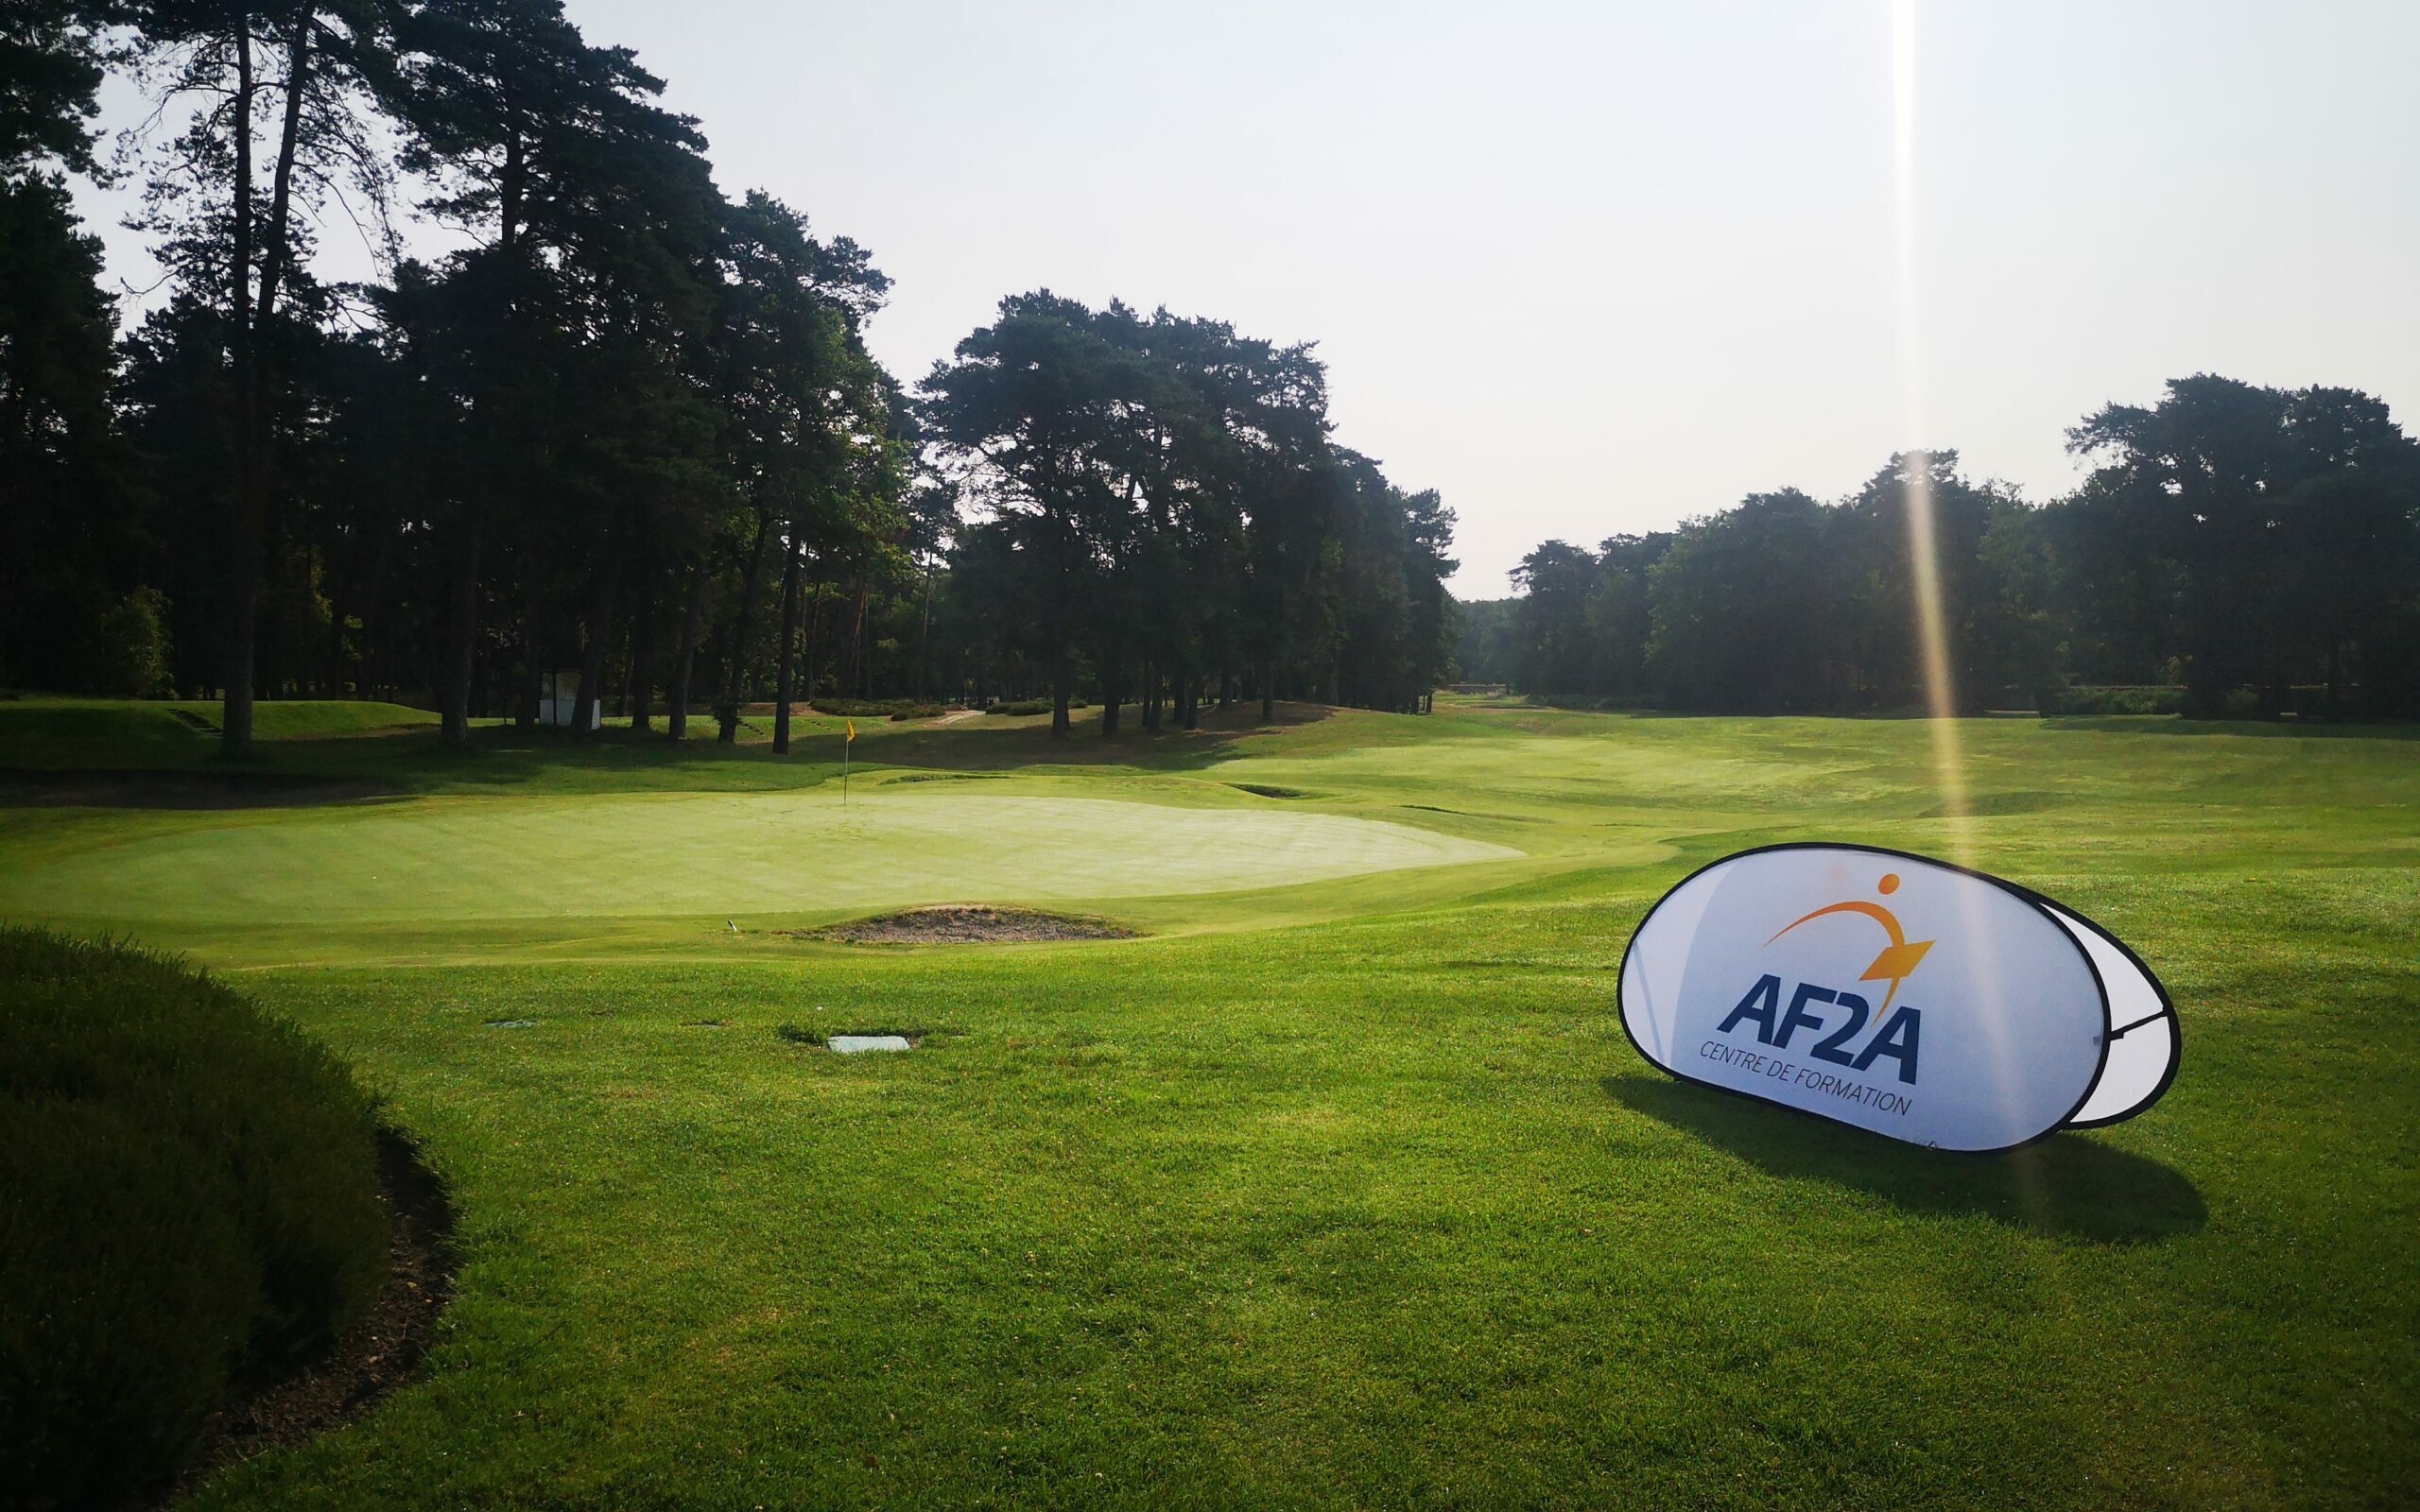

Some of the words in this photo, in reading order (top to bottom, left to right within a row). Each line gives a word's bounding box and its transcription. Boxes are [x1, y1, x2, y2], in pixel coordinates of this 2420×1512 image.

[1717, 973, 1921, 1085] AF2A
[1700, 1040, 1766, 1073] CENTRE
[1766, 1057, 1794, 1082] DE
[1794, 1068, 1911, 1115] FORMATION
